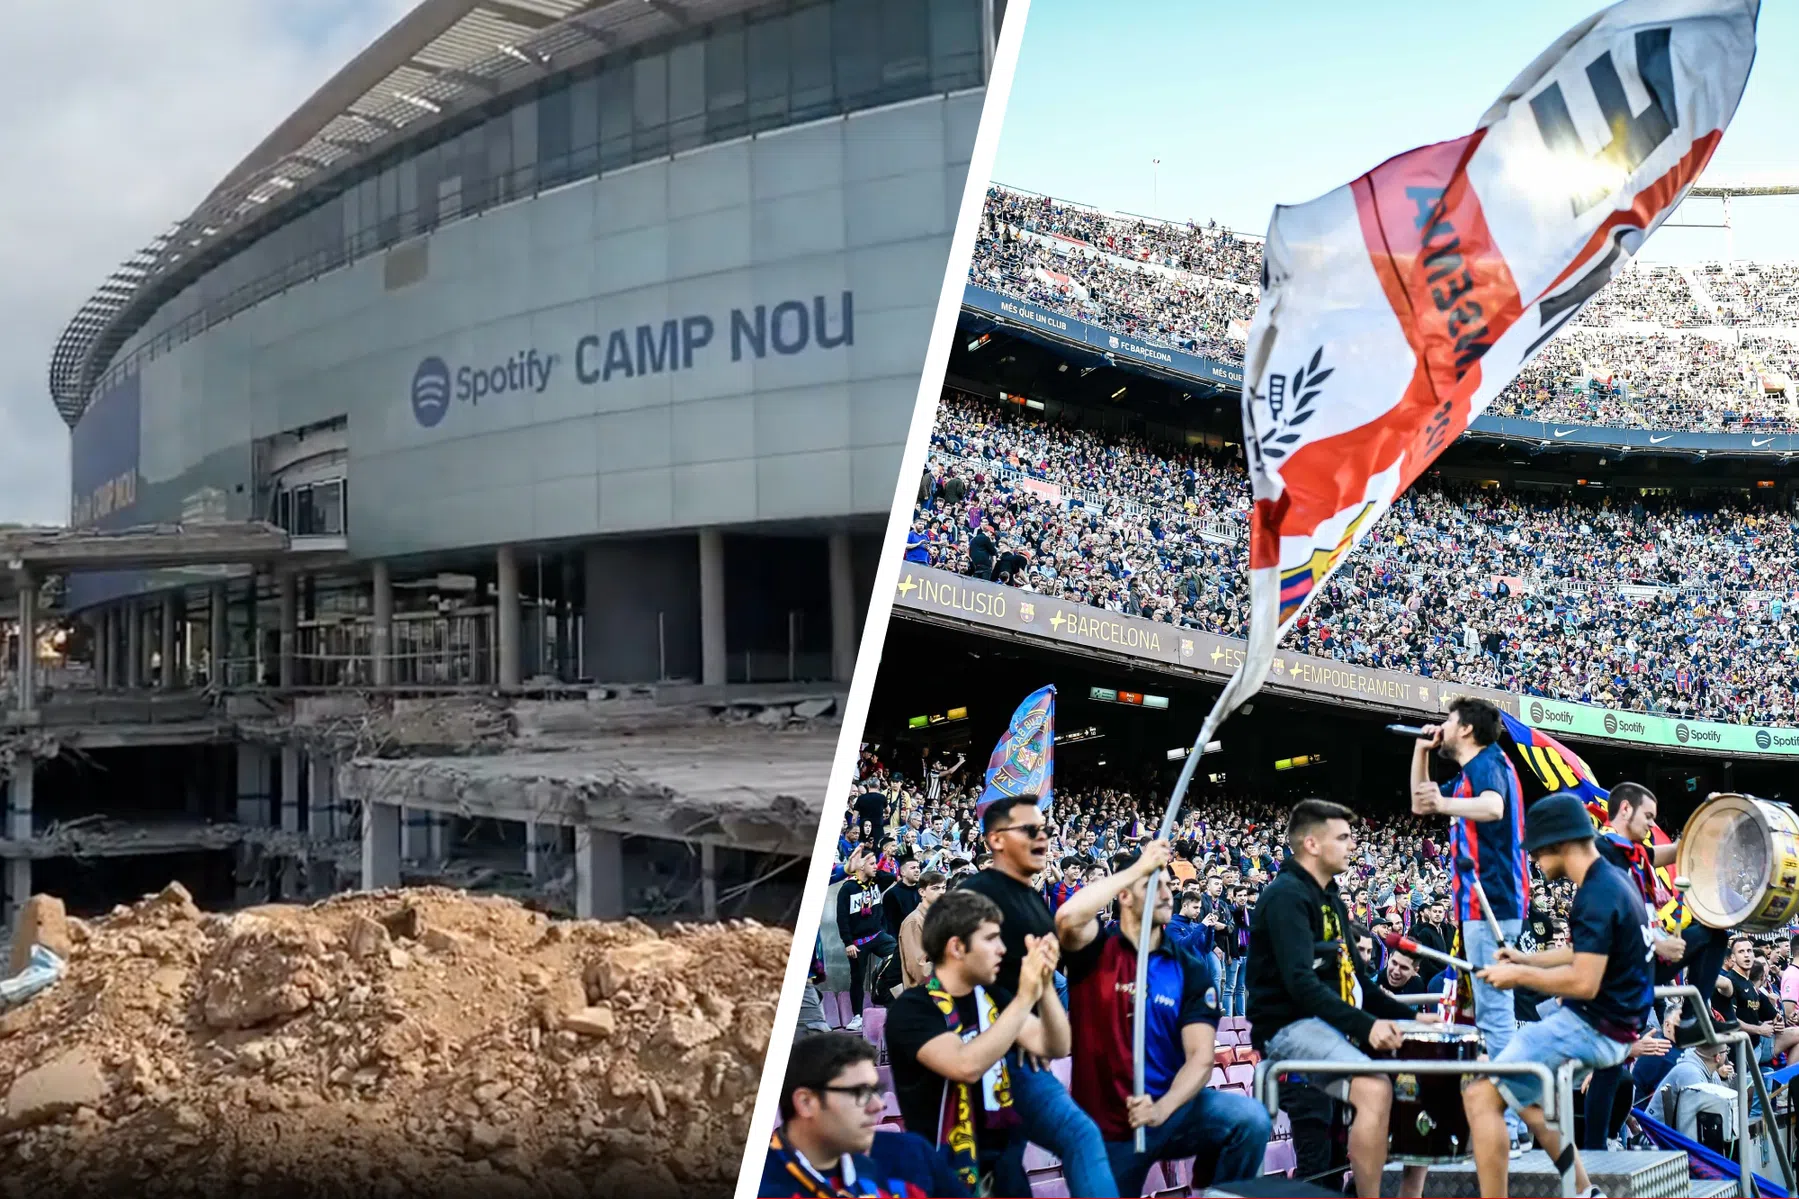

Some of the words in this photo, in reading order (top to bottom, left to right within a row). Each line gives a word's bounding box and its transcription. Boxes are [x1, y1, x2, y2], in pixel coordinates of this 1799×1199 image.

[1001, 301, 1017, 314] MÉS
[1018, 308, 1035, 320] QUE
[1035, 313, 1047, 324] UN
[1047, 317, 1067, 330] CLUB
[456, 348, 553, 405] Spotify
[575, 315, 714, 385] CAMP
[730, 291, 855, 362] NOU
[1120, 341, 1130, 351] FC
[1130, 344, 1172, 363] BARCELONA
[1212, 367, 1227, 378] MÉS
[1228, 371, 1243, 382] QUE
[1545, 708, 1574, 725] Spotify
[1619, 720, 1646, 735] Spotify
[1691, 729, 1722, 743] Spotify
